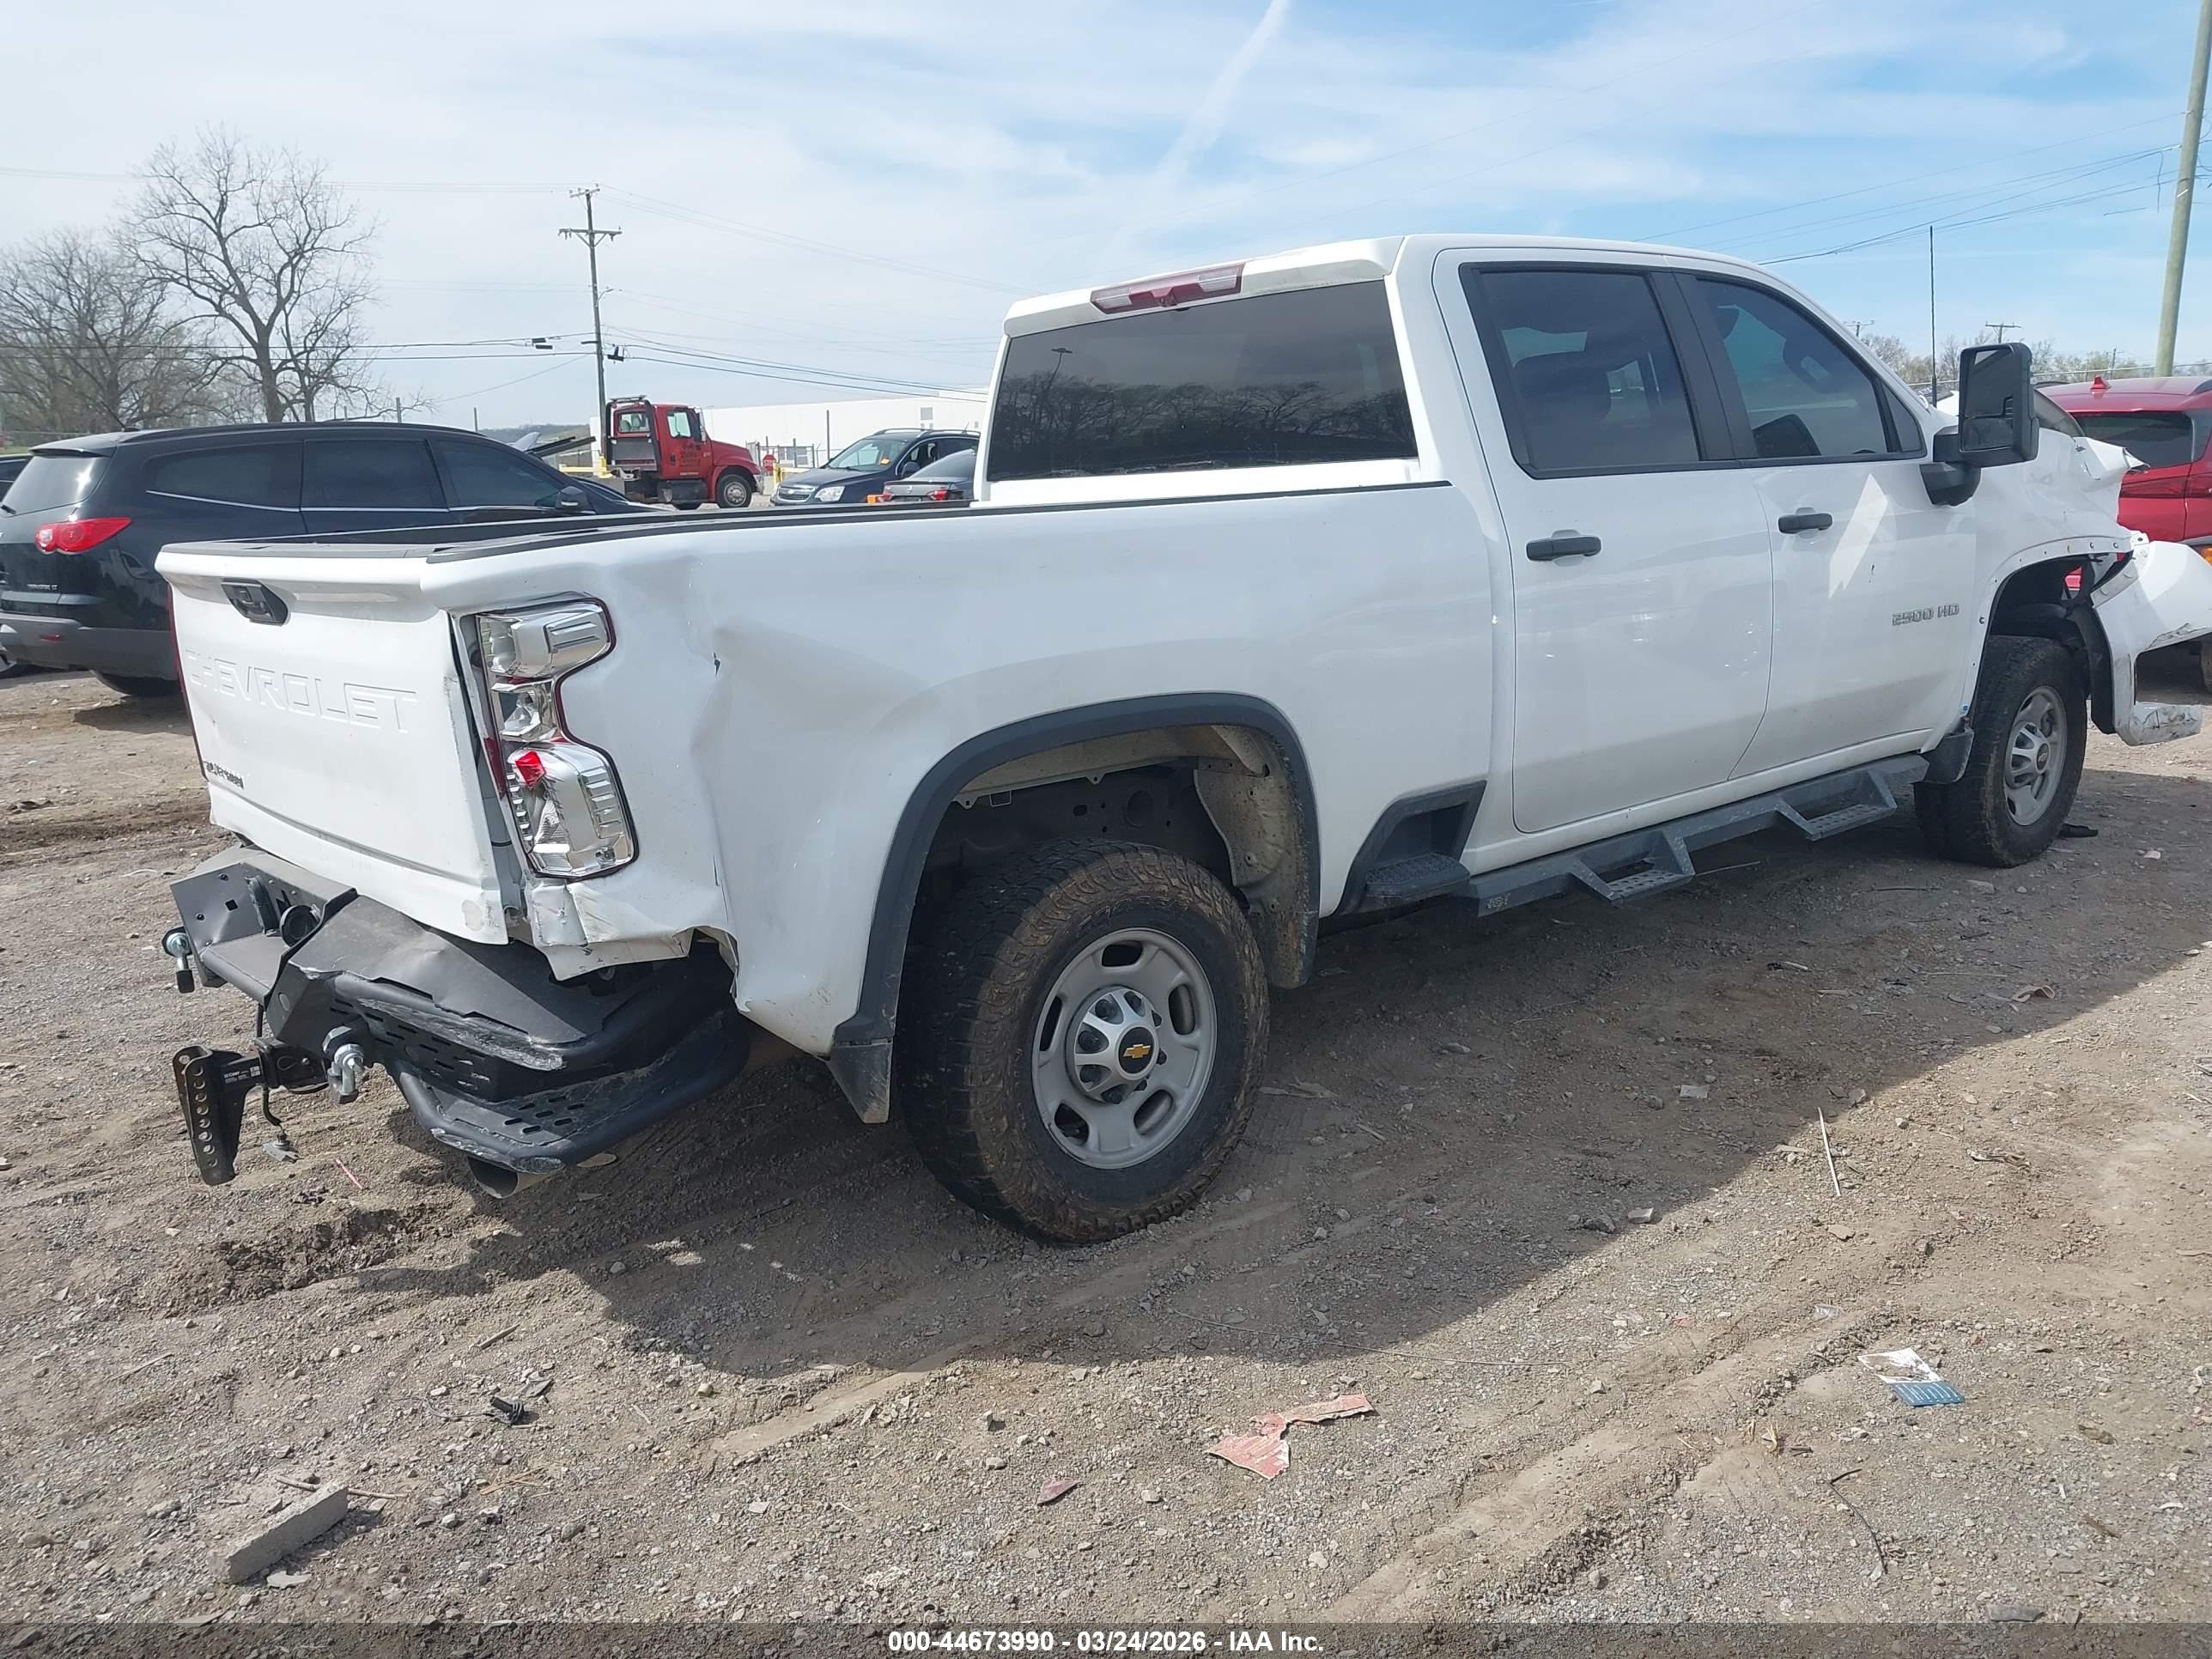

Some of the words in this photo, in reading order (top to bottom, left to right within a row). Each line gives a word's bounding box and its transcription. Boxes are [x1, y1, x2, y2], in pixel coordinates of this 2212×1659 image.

[1892, 608, 1934, 626] 2500
[1937, 603, 1960, 618] HD
[185, 649, 418, 734] CHEVROLET
